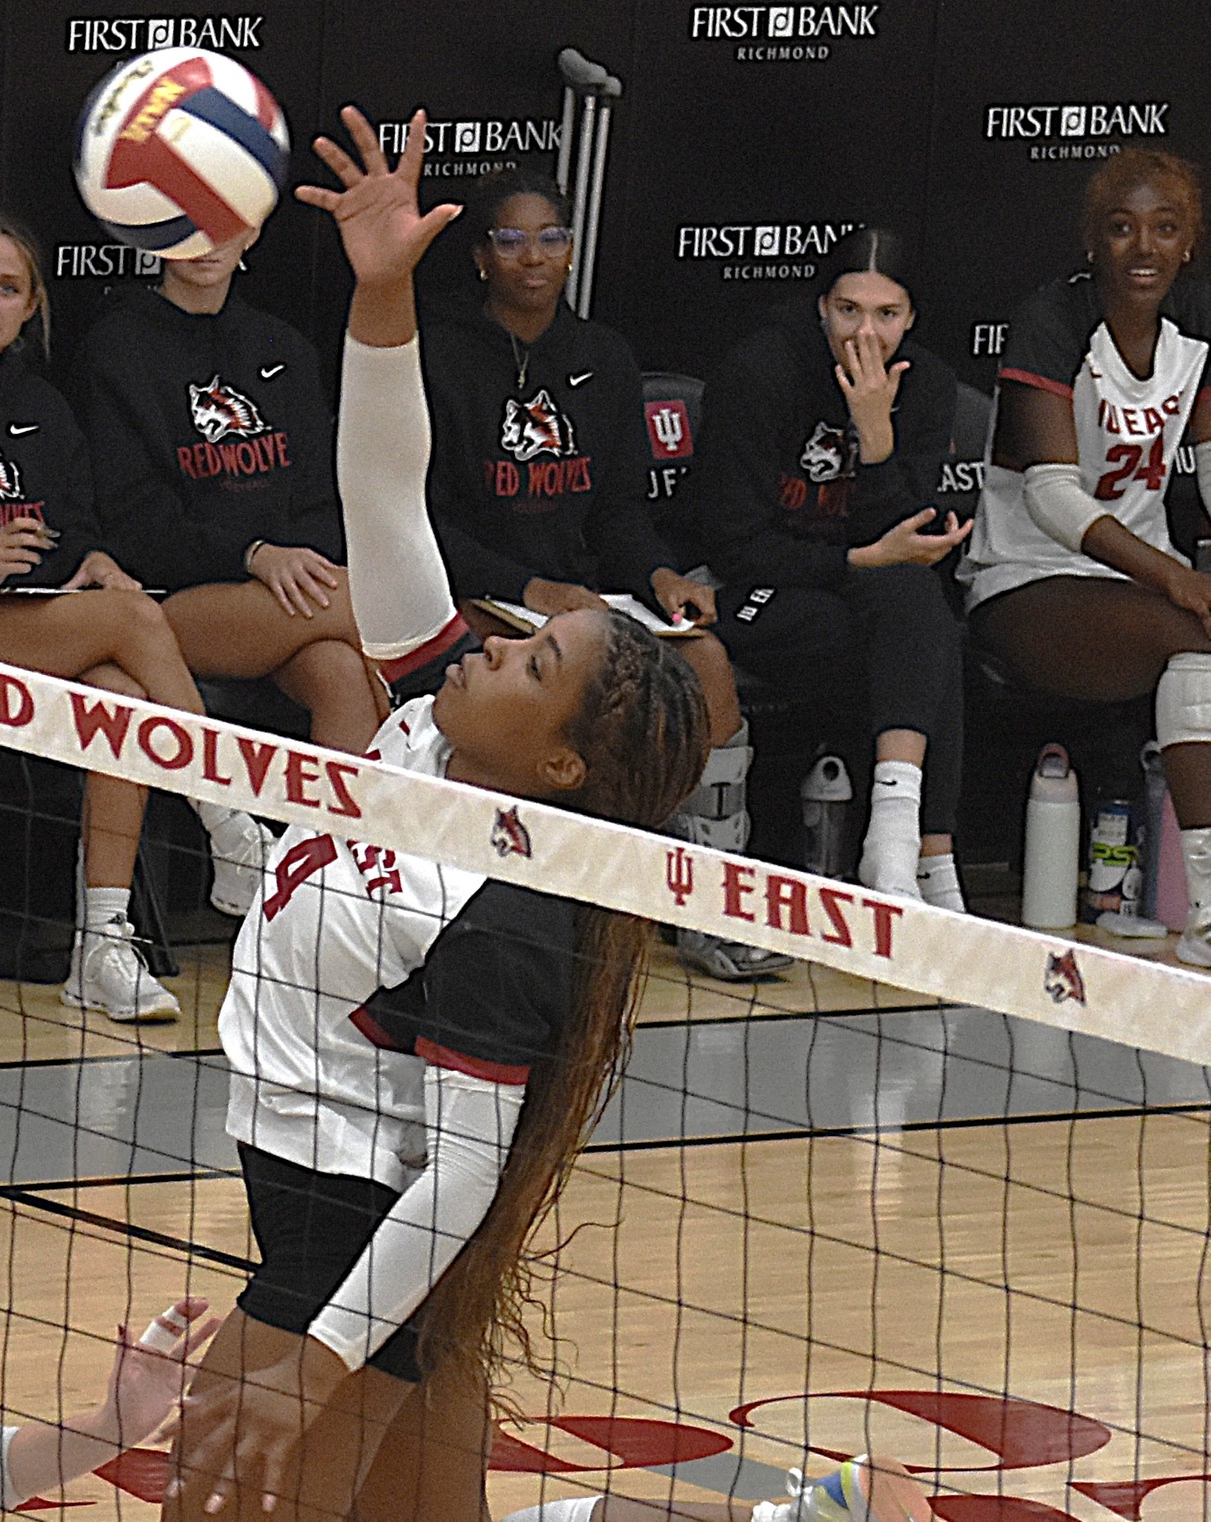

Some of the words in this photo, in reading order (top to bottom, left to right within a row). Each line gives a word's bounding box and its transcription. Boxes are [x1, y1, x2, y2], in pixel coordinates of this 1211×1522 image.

[69, 19, 146, 51] FIRST
[179, 16, 263, 48] BANK
[692, 7, 767, 38] FIRST
[798, 5, 879, 36] BANK
[737, 46, 830, 60] RICHMOND
[485, 120, 564, 152] BANK
[986, 106, 1060, 138] FIRST
[1090, 103, 1169, 135] BANK
[678, 226, 753, 258] FIRST
[56, 245, 132, 277] FIRST
[724, 264, 816, 279] RICHMOND
[219, 432, 292, 478] WOLVE
[1093, 433, 1167, 502] 24
[69, 691, 363, 819] WOLVES
[721, 860, 904, 960] EAST
